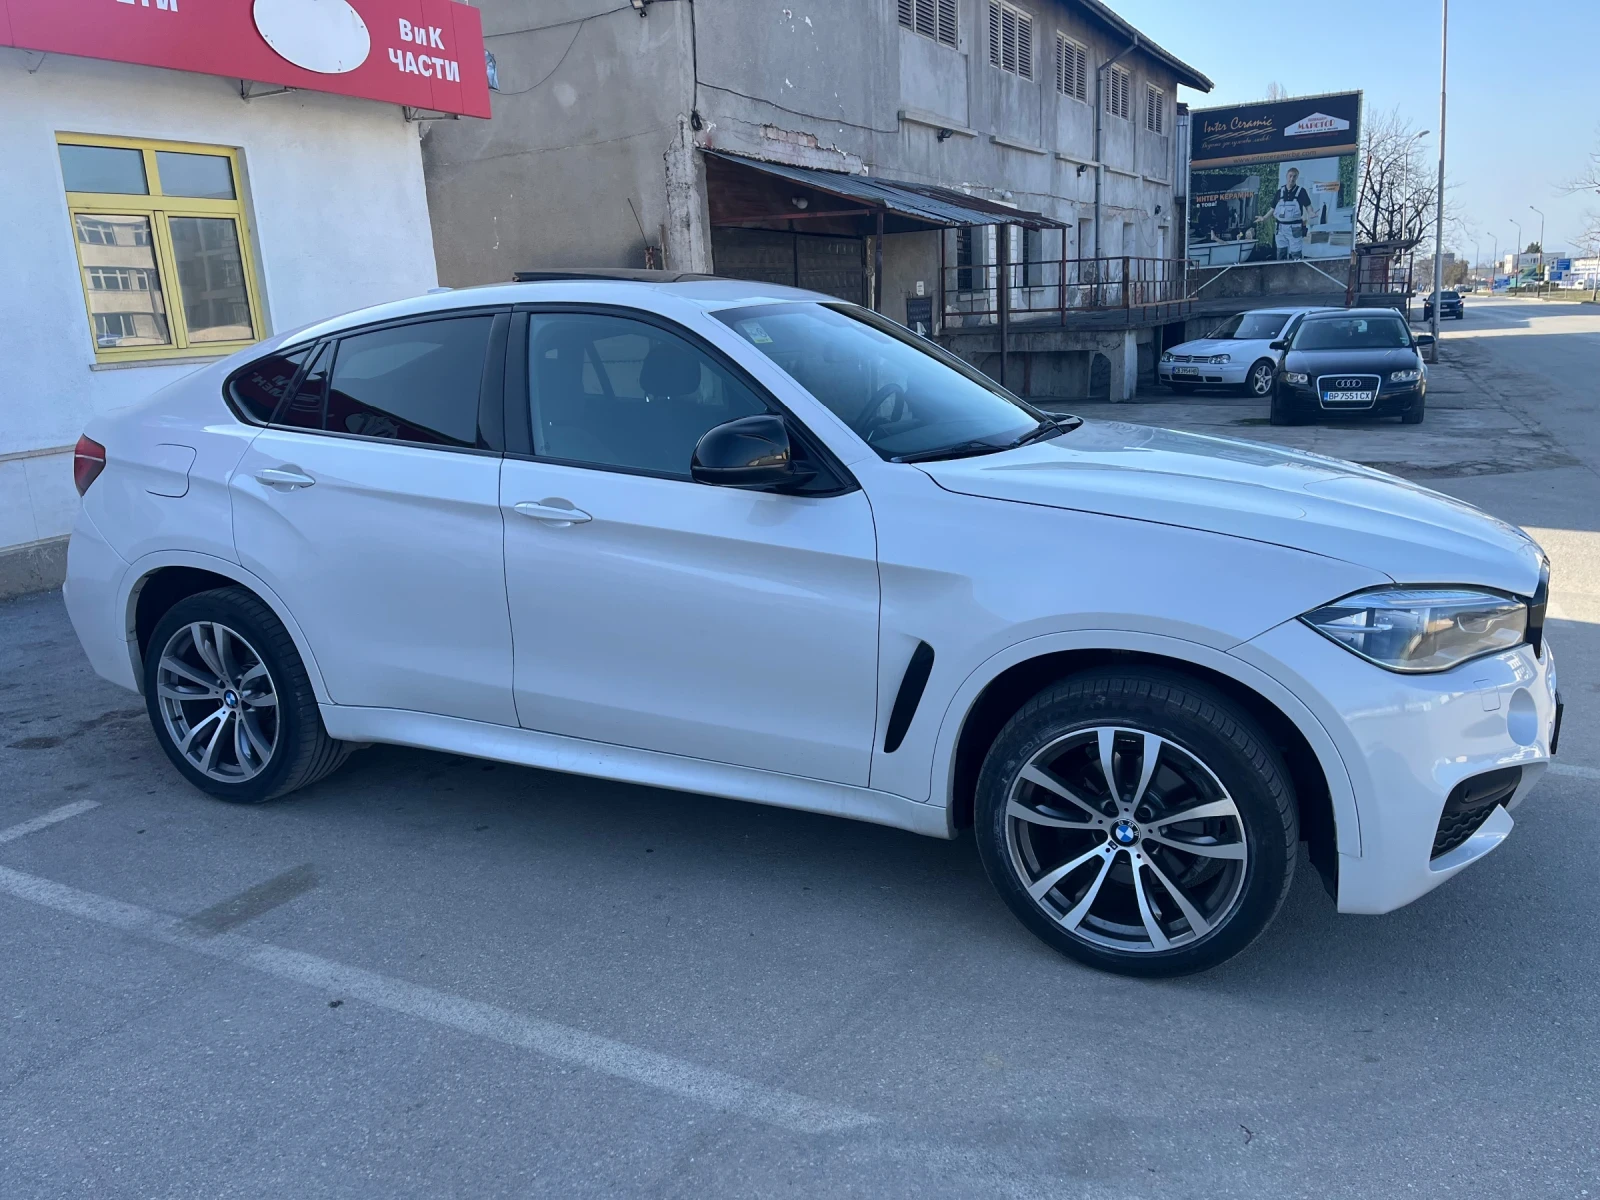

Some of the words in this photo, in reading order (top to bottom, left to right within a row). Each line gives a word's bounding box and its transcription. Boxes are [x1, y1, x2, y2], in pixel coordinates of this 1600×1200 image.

[388, 47, 460, 82] ЧАСТИ
[1203, 120, 1228, 133] Inter
[1230, 115, 1273, 130] Ceramic
[1233, 150, 1317, 164] www.interceramicbg.com
[1196, 194, 1219, 203] ИНТЕР
[1219, 191, 1254, 201] КЕРАМИК
[1328, 392, 1339, 400] BP
[1340, 392, 1358, 400] 7551
[1360, 392, 1370, 400] CX
